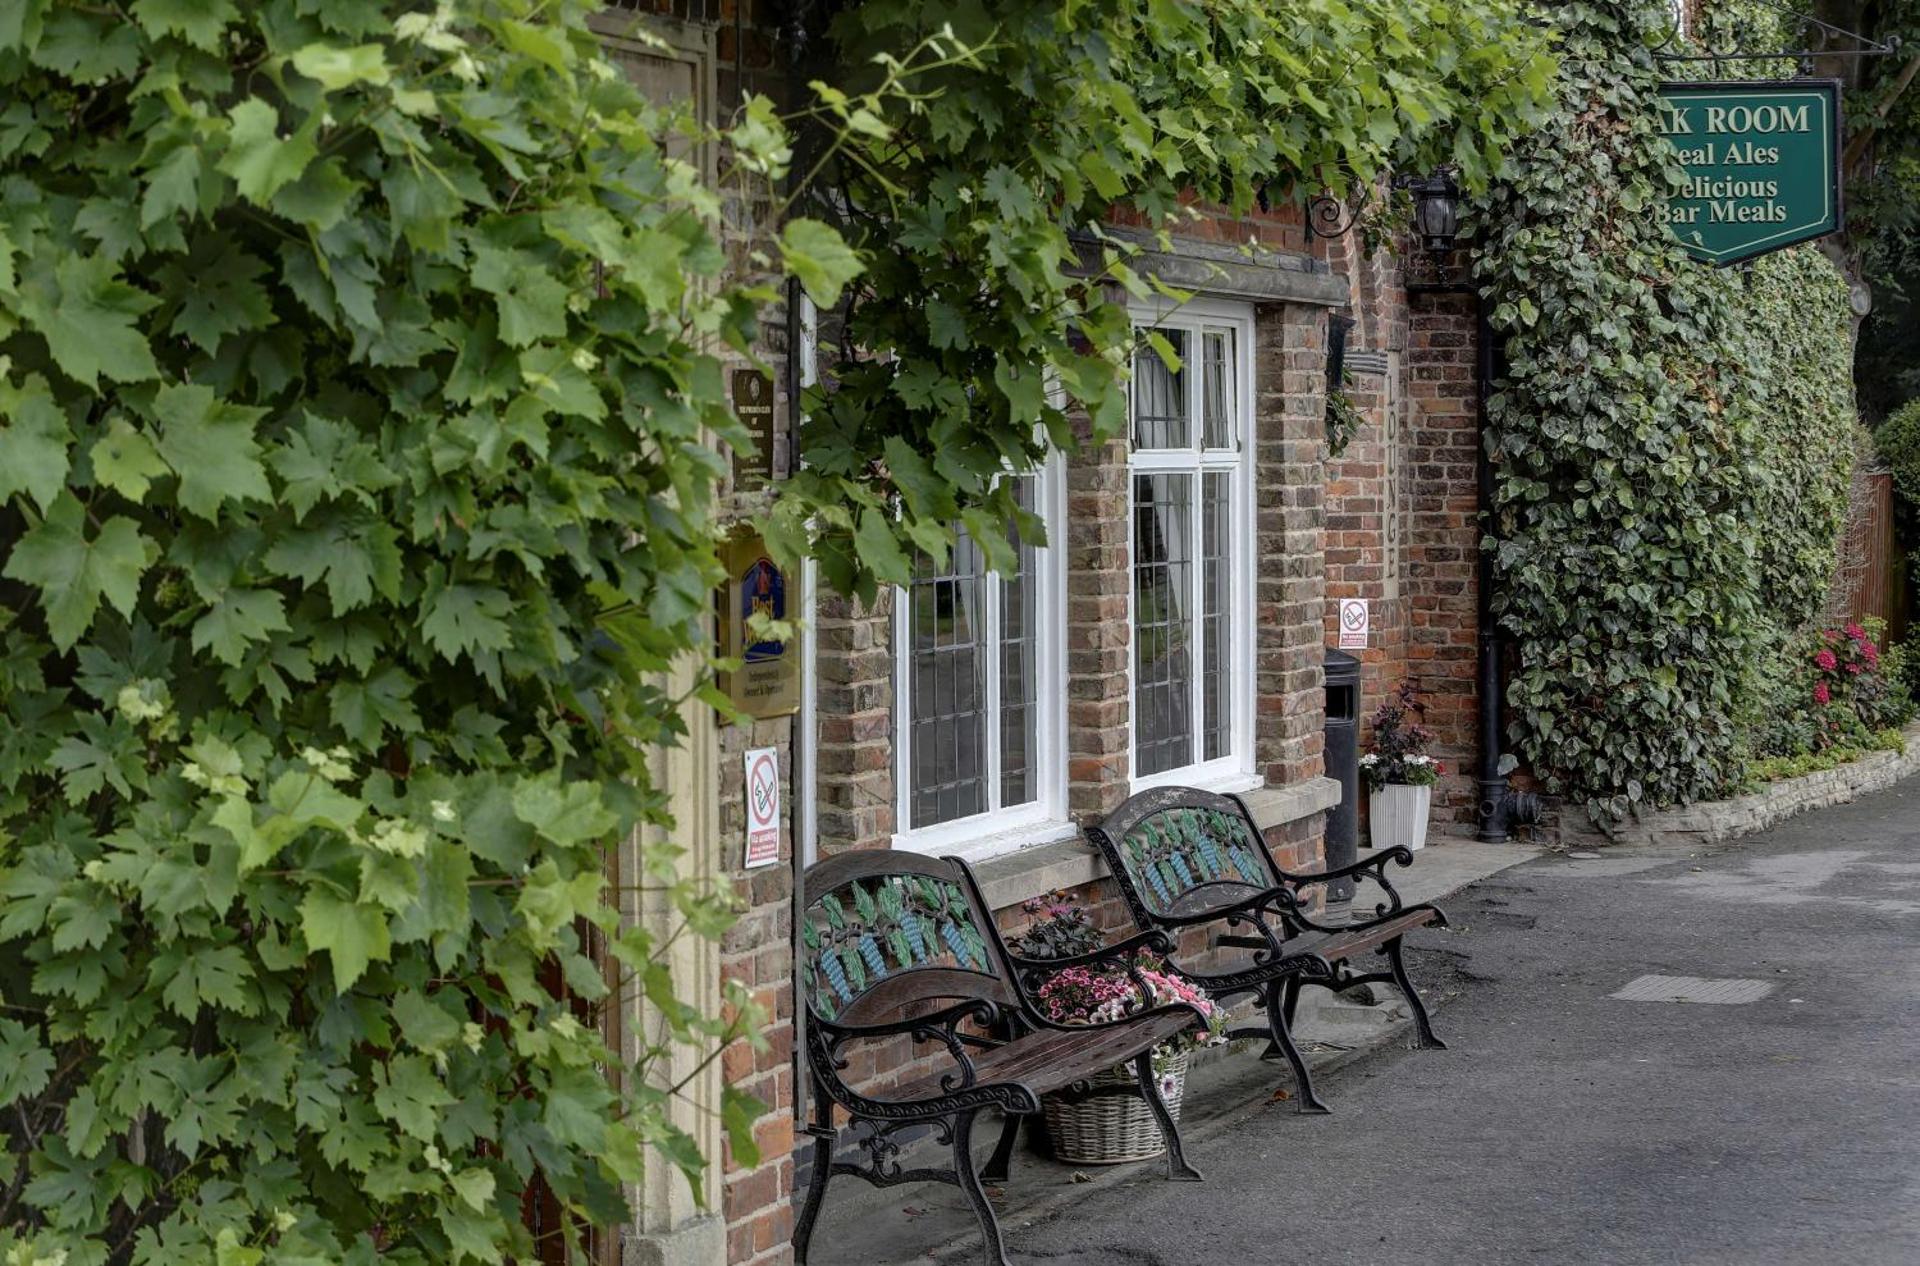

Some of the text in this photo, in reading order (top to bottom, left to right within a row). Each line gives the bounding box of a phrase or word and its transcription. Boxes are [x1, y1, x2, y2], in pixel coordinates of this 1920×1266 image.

[1653, 105, 1812, 134] AK ROOM
[1678, 143, 1779, 165] eal Ales
[1655, 200, 1787, 223] Bar Meals
[1386, 374, 1396, 578] LOUNGE
